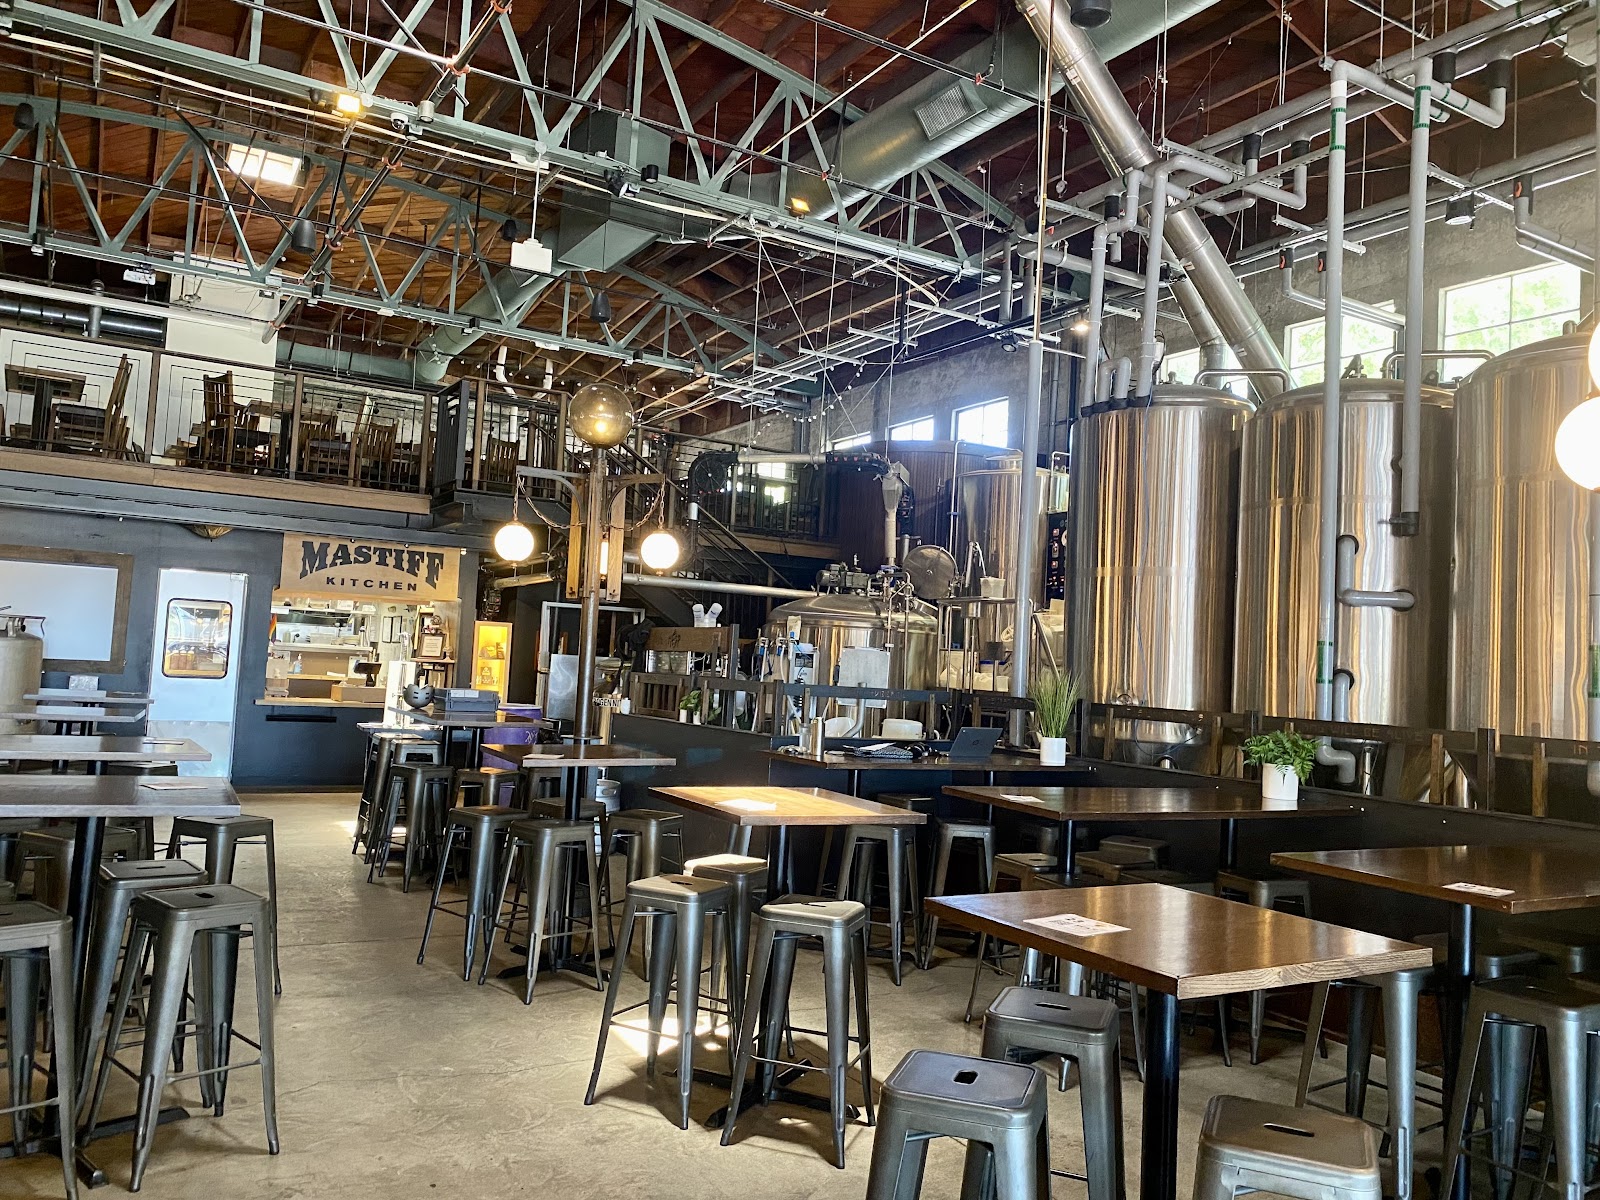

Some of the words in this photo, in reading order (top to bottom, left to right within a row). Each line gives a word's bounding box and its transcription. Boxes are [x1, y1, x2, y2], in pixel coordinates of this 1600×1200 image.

[300, 540, 444, 589] MASTIFF
[326, 576, 417, 591] KITCHEN
[1331, 724, 1359, 736] WILL
